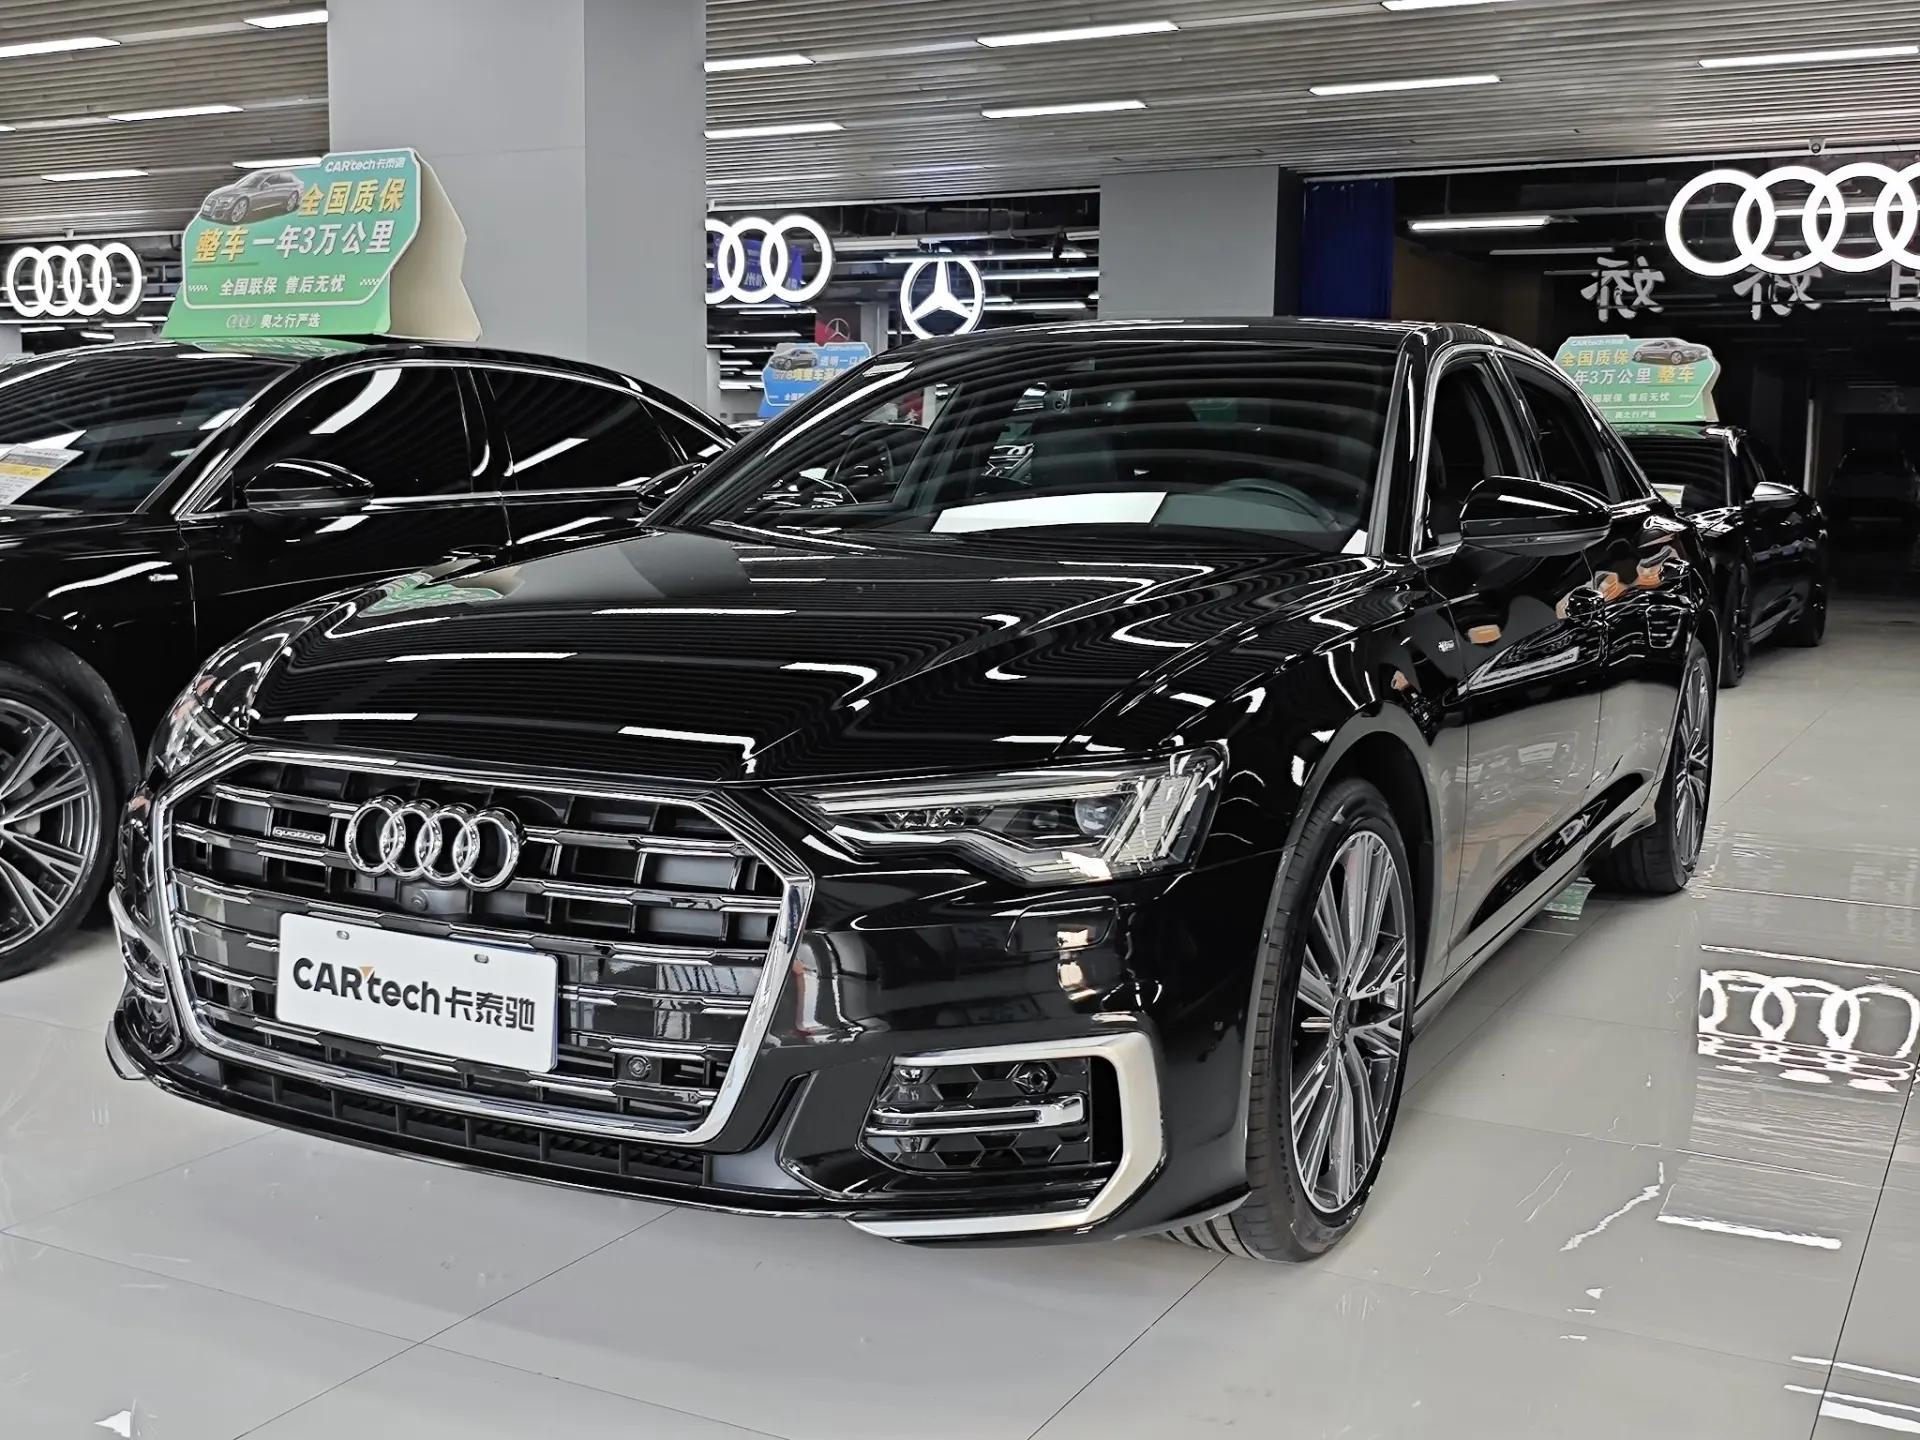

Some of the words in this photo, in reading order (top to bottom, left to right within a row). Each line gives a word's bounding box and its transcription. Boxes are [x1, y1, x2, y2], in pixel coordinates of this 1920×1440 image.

[299, 178, 407, 217] 全国质保
[192, 224, 249, 264] 整车
[252, 219, 395, 259] 一年3万公里
[219, 277, 277, 296] 全国联保
[285, 275, 346, 295] 售后无忧
[260, 312, 321, 329] 奥之行严选
[1559, 349, 1630, 367] 全国质保
[1657, 365, 1696, 384] 整车
[1588, 392, 1623, 403] 国联保
[275, 829, 323, 842] quattro
[291, 956, 536, 1033] CARtech卡泰驰
